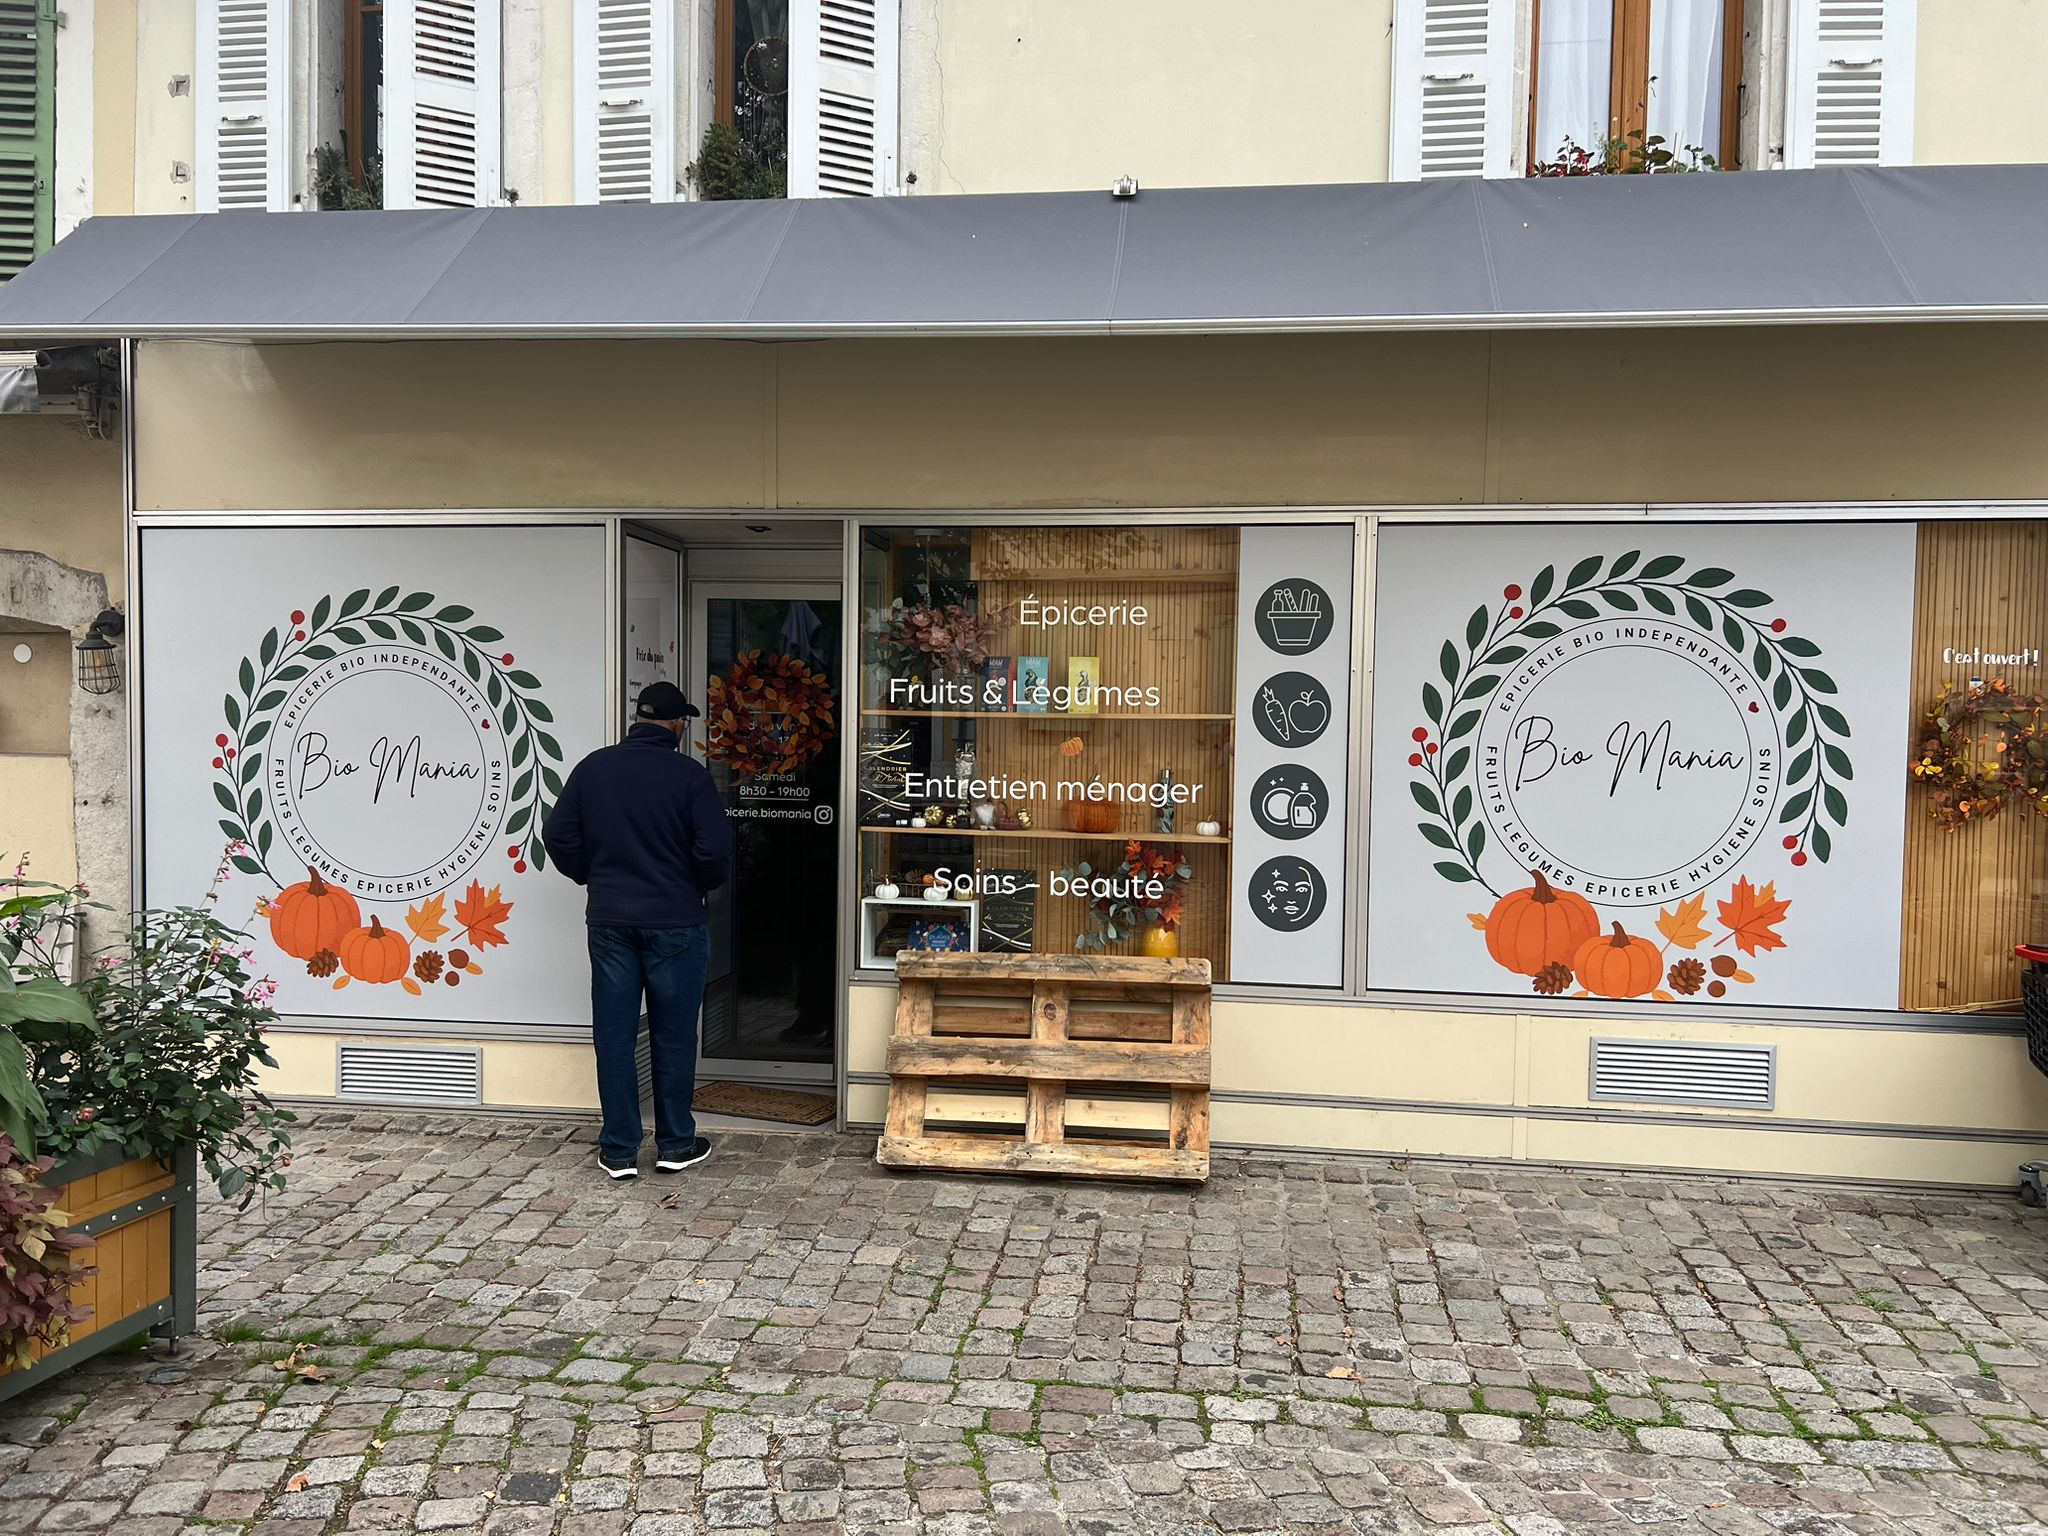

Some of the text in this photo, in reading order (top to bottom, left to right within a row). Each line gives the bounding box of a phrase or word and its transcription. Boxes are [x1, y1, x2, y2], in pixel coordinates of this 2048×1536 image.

[1019, 594, 1149, 631] Épicerie
[1500, 627, 1748, 712] EPICERIE BIO INDEPENDANTE
[1943, 647, 1980, 664] C'est
[1983, 648, 2030, 666] ouvert
[284, 653, 481, 729] EPICERIE BIO INDEPENDANTE
[890, 677, 1161, 711] Fruits & Légumes
[297, 731, 480, 805] Bio Mania
[1514, 715, 1745, 798] Bio Mania
[739, 786, 767, 796] 8h30
[778, 787, 811, 797] 19h00
[754, 772, 796, 782] Samedi
[904, 772, 1204, 809] Entretien ménager
[275, 758, 501, 894] FRUITS LEGUMES EPICERIE HYGIENE SOINS
[1486, 746, 1771, 898] FRUITS LEGUMES EPICERIE HYGIENE SOINS
[933, 867, 1017, 895] Soins
[1050, 870, 1164, 900] beauté
